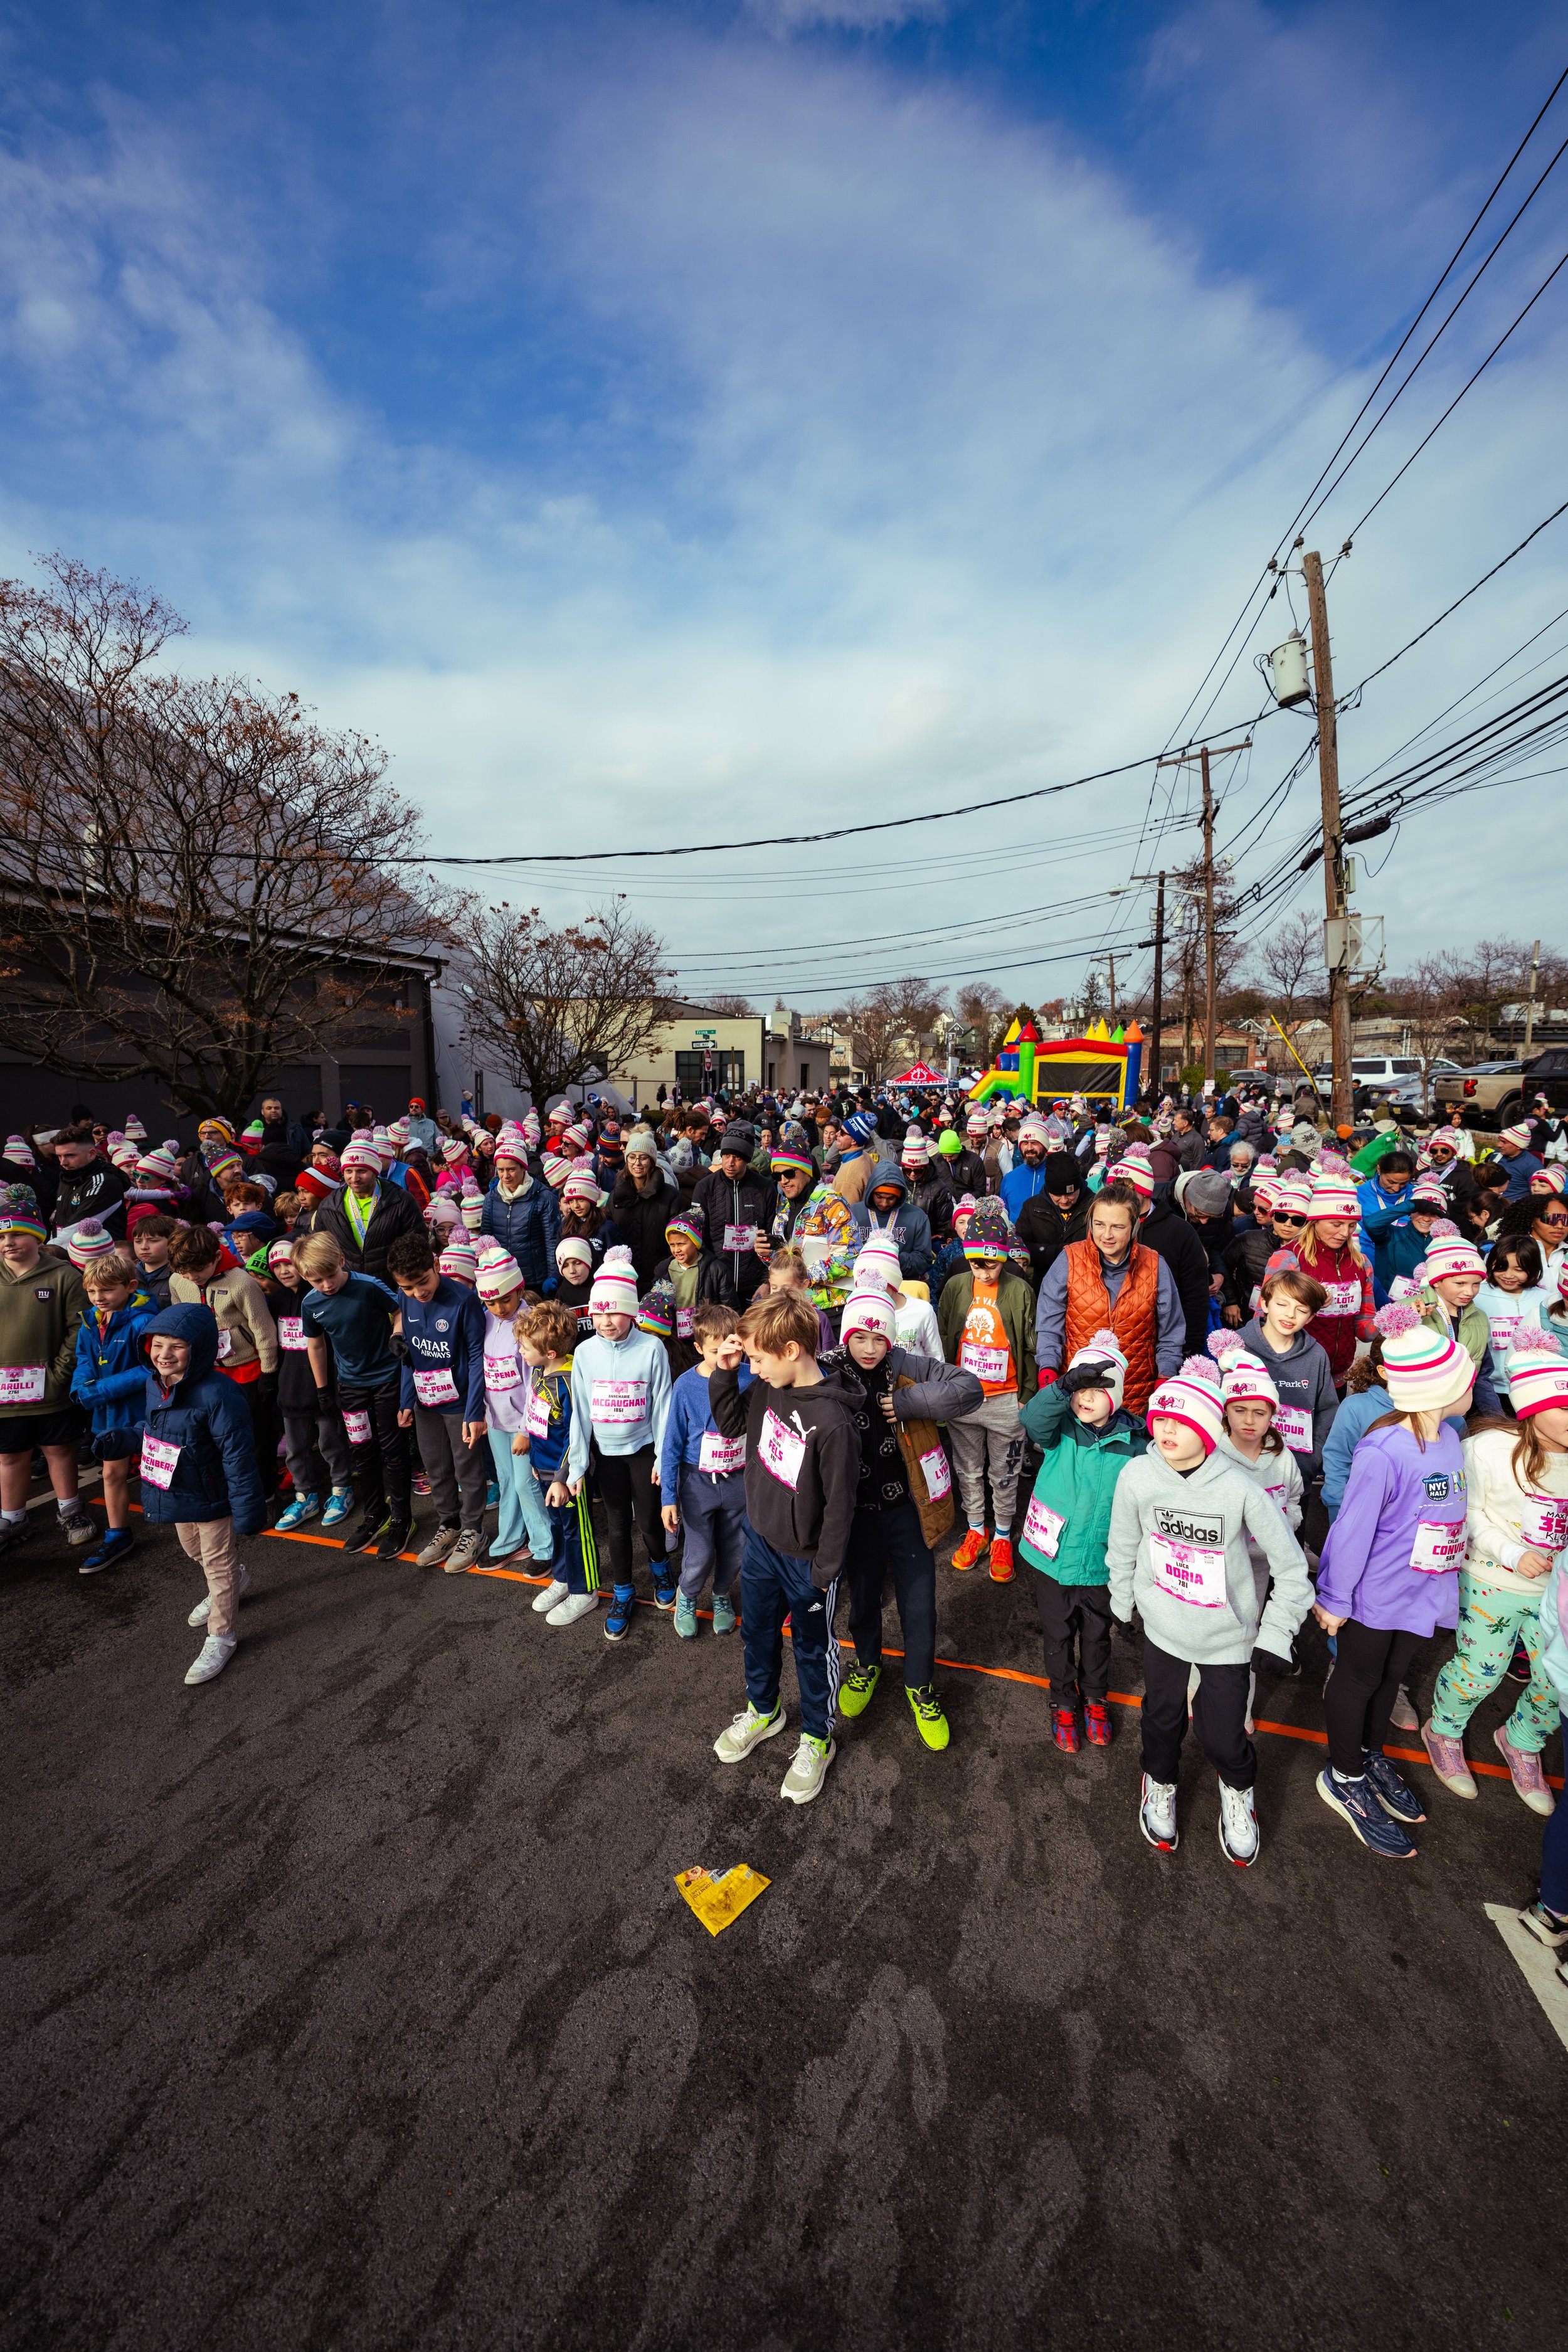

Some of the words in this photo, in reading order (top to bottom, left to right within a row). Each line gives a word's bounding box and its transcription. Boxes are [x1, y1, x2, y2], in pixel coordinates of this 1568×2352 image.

[578, 1319, 596, 1332] FTB
[411, 1336, 450, 1351] QATAR
[421, 1349, 451, 1359] AIRWAYS
[964, 1357, 1003, 1370] PATCHETT
[0, 1382, 34, 1391] ARULLI
[417, 1384, 453, 1394] CIDE-PENA
[592, 1397, 646, 1407] MCGAUGHAN
[711, 1446, 743, 1458] HERBST
[768, 1439, 783, 1461] FELS
[1429, 1481, 1447, 1491] NYC
[1160, 1520, 1219, 1542] adidas
[1546, 1532, 1568, 1540] KLO
[1432, 1540, 1465, 1555] CONVIE
[1176, 1561, 1189, 1570] LUCA
[1165, 1563, 1204, 1586] DORIA
[1178, 1579, 1188, 1589] 781
